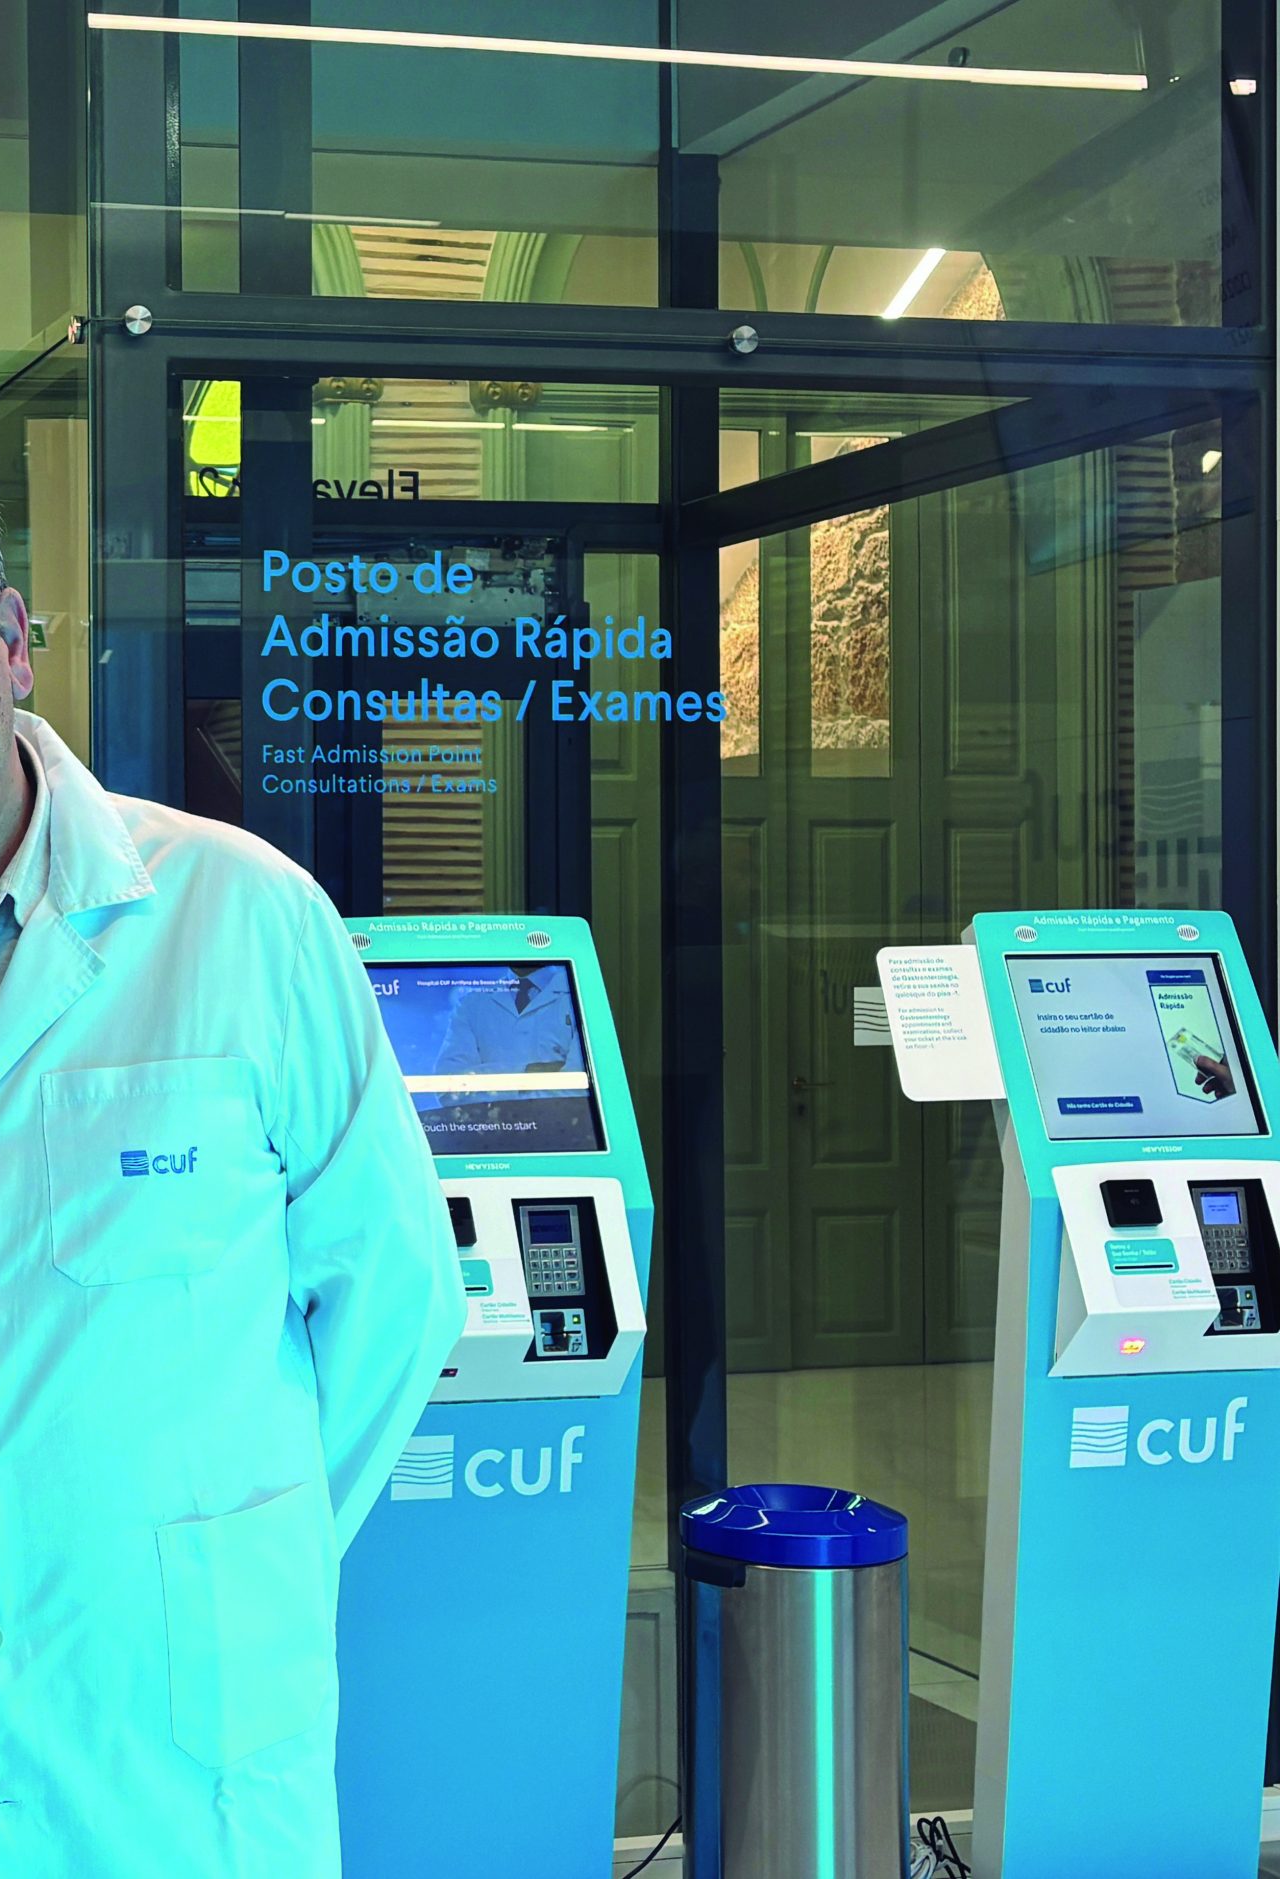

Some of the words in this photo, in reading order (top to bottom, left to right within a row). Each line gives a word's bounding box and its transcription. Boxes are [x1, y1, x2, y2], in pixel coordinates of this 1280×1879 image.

[263, 550, 399, 594] Posto
[413, 550, 474, 594] de
[261, 613, 500, 659] Admissão
[515, 615, 672, 671] Rápida
[262, 677, 503, 722] Consultas
[516, 680, 537, 722] /
[551, 679, 727, 723] Exames
[262, 744, 306, 764] Fast
[310, 743, 423, 764] Admission
[428, 744, 482, 764] Point
[262, 773, 412, 794] Consultations
[416, 775, 426, 793] /
[431, 773, 498, 793] Exams
[368, 921, 420, 932] Admissão
[421, 921, 458, 933] Rápida
[468, 920, 526, 933] Pagamento
[1033, 916, 1080, 925] Admissão
[1080, 915, 1114, 927] Rápida
[1122, 915, 1175, 927] Pagamento
[372, 979, 400, 996] cuf
[1045, 978, 1072, 993] cuf
[1079, 1012, 1104, 1021] cartão
[1104, 1012, 1115, 1020] de
[450, 1121, 466, 1132] the
[467, 1122, 501, 1132] screen
[502, 1121, 513, 1131] to
[514, 1121, 538, 1131] start
[152, 1146, 198, 1175] cuf
[1136, 1396, 1249, 1466] cuf
[464, 1425, 586, 1498] cuf
